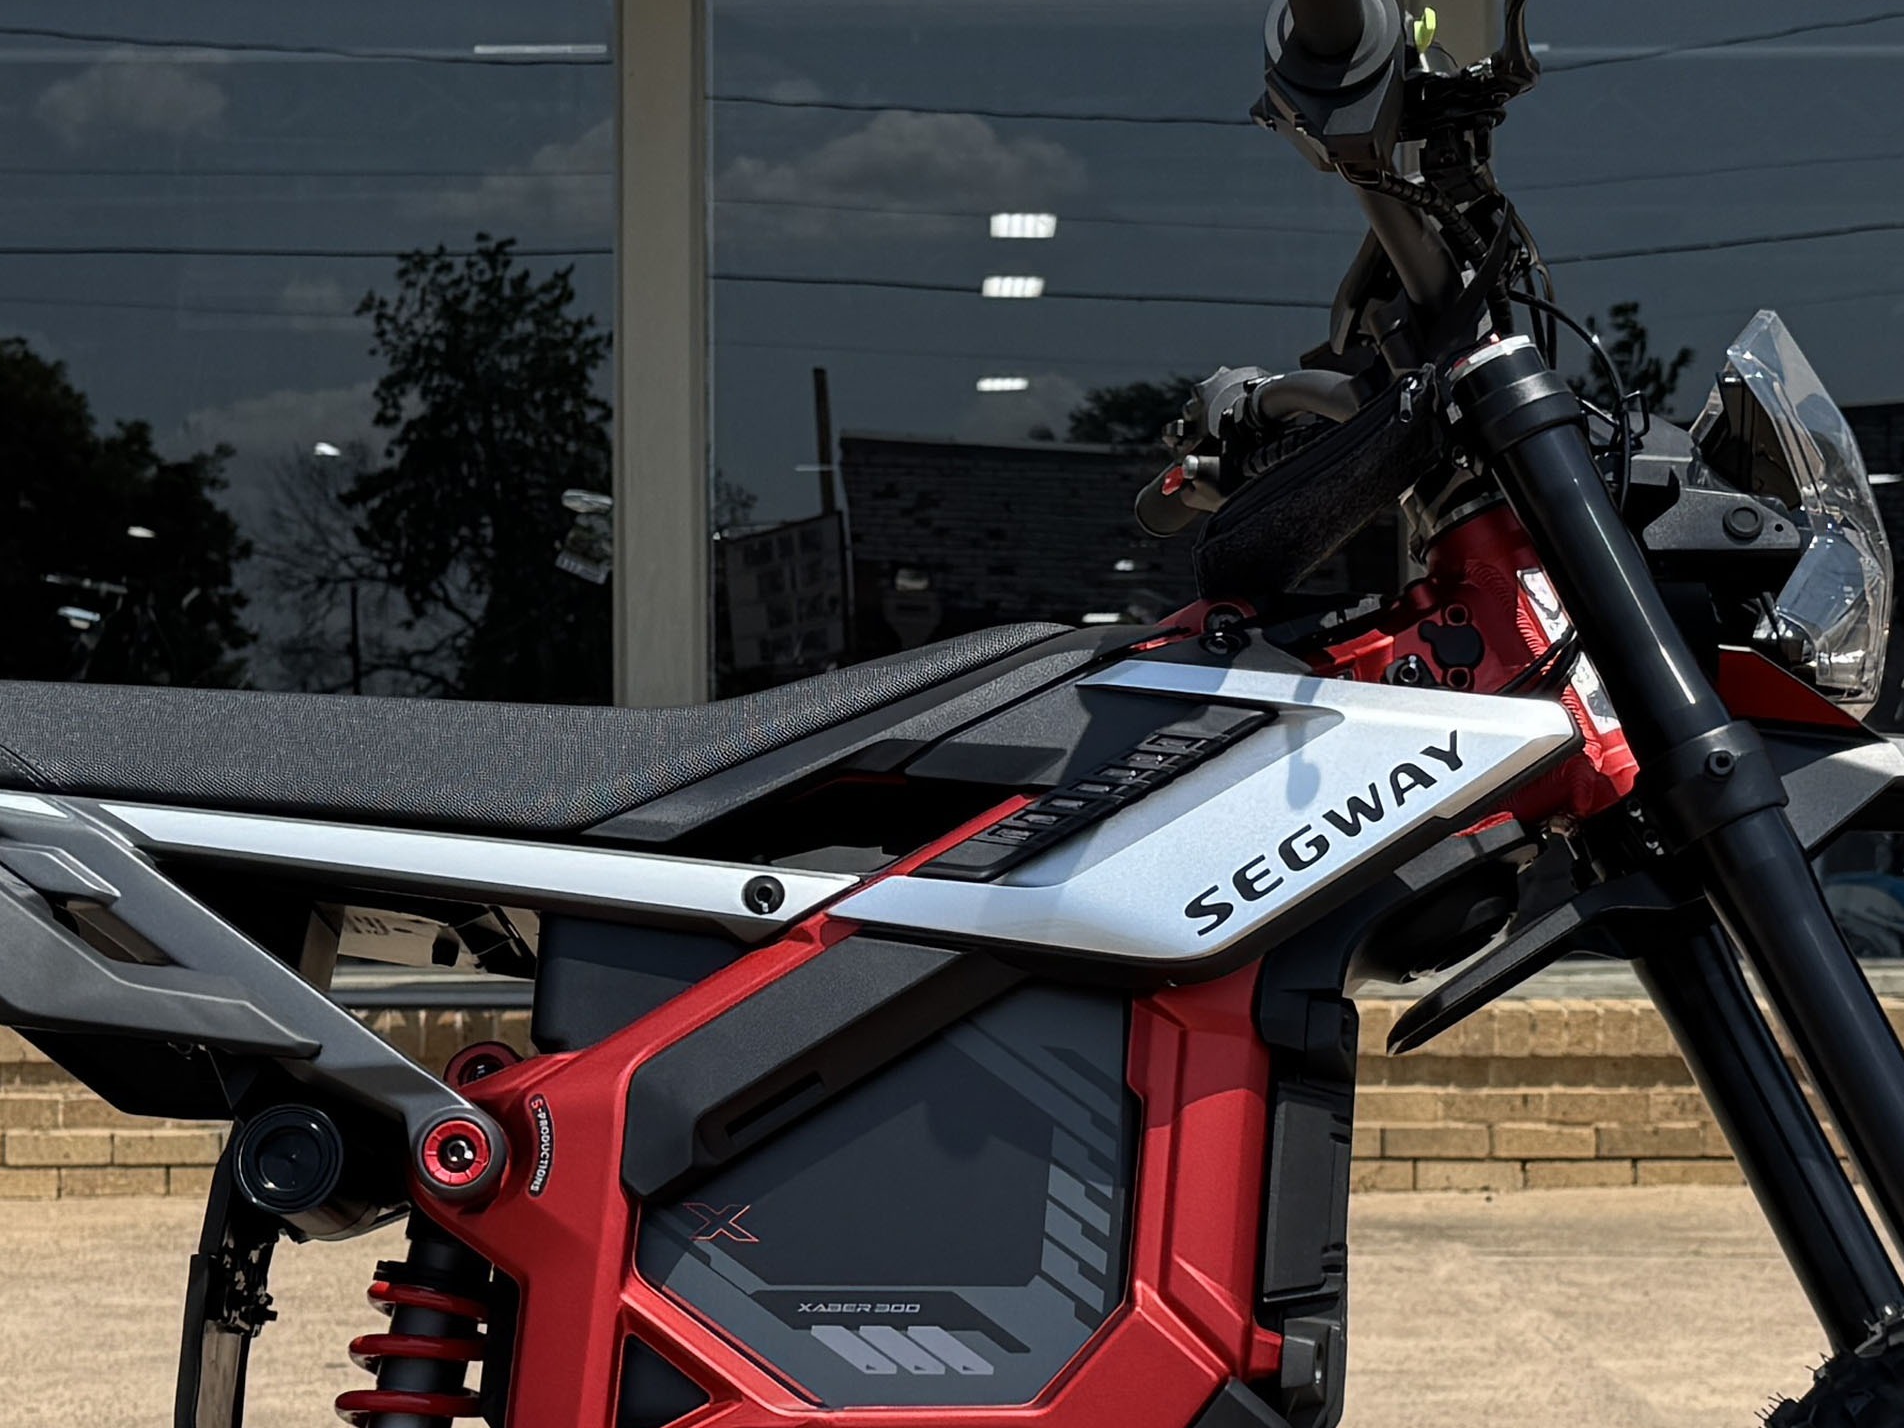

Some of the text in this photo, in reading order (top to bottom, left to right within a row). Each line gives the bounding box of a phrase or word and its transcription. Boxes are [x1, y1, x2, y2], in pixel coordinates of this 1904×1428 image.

[1184, 730, 1463, 936] SEGWAY
[797, 1302, 921, 1314] XABER 300
